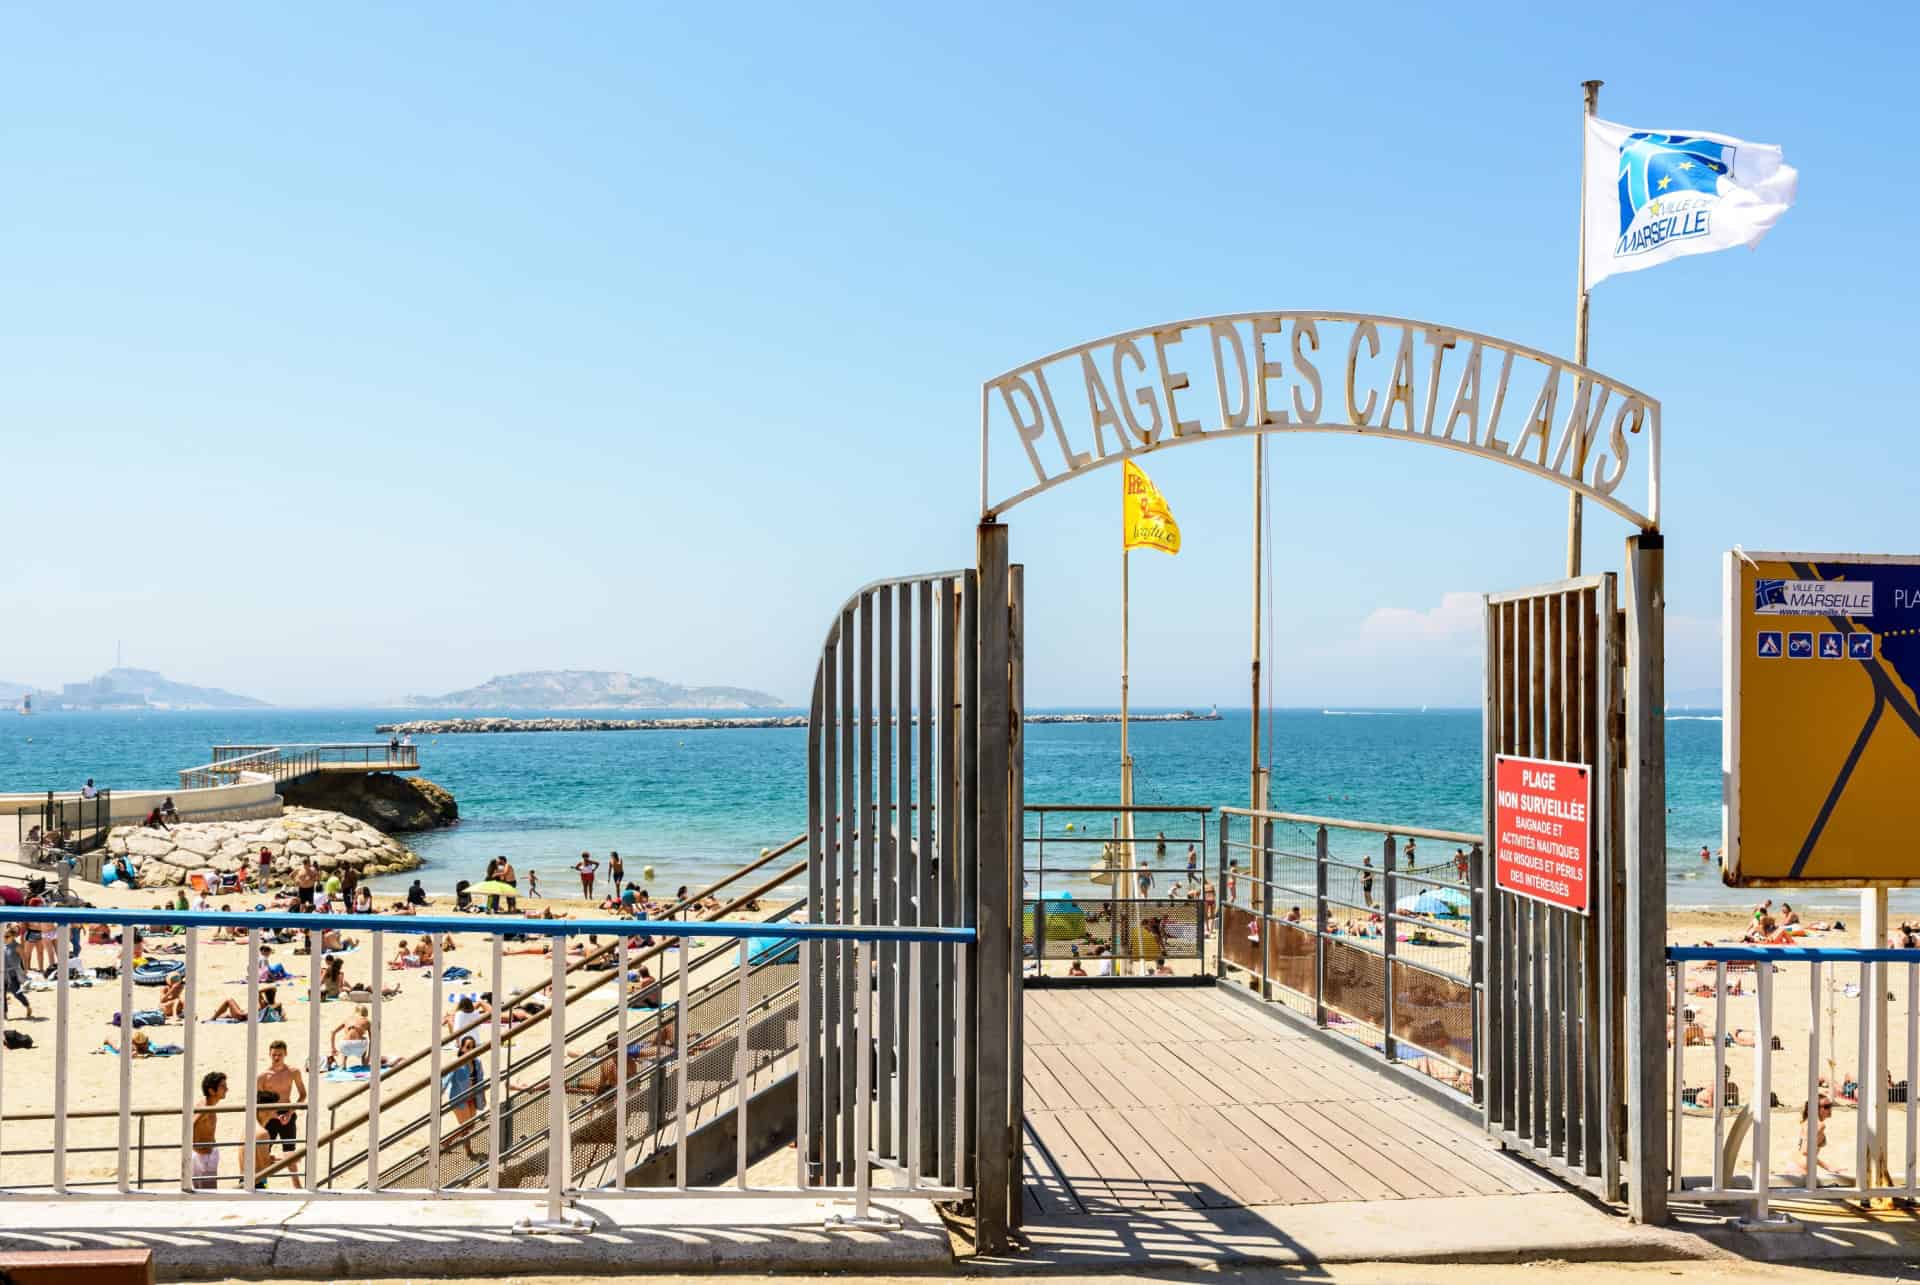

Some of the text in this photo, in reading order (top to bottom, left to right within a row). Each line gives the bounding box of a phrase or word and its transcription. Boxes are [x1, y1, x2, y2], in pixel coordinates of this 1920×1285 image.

[1616, 210, 1708, 254] MARSEILLE
[1001, 317, 1643, 496] PLAGE DES CATALANS
[1790, 594, 1870, 608] MARSEILLE
[1792, 584, 1825, 592] VILLE DE
[1779, 608, 1849, 616] www.marseille.fr
[1522, 769, 1556, 791] PLAGE
[1498, 790, 1585, 821] NON SURVEILLÉE
[1515, 816, 1563, 837] BAIGNADE ET
[1502, 831, 1580, 861] ACTIVITÉS NAUTIQUES
[1499, 849, 1583, 881] AUX RISQUES ET PÉRILS
[1510, 869, 1569, 897] DES INTÉRESSÉS
